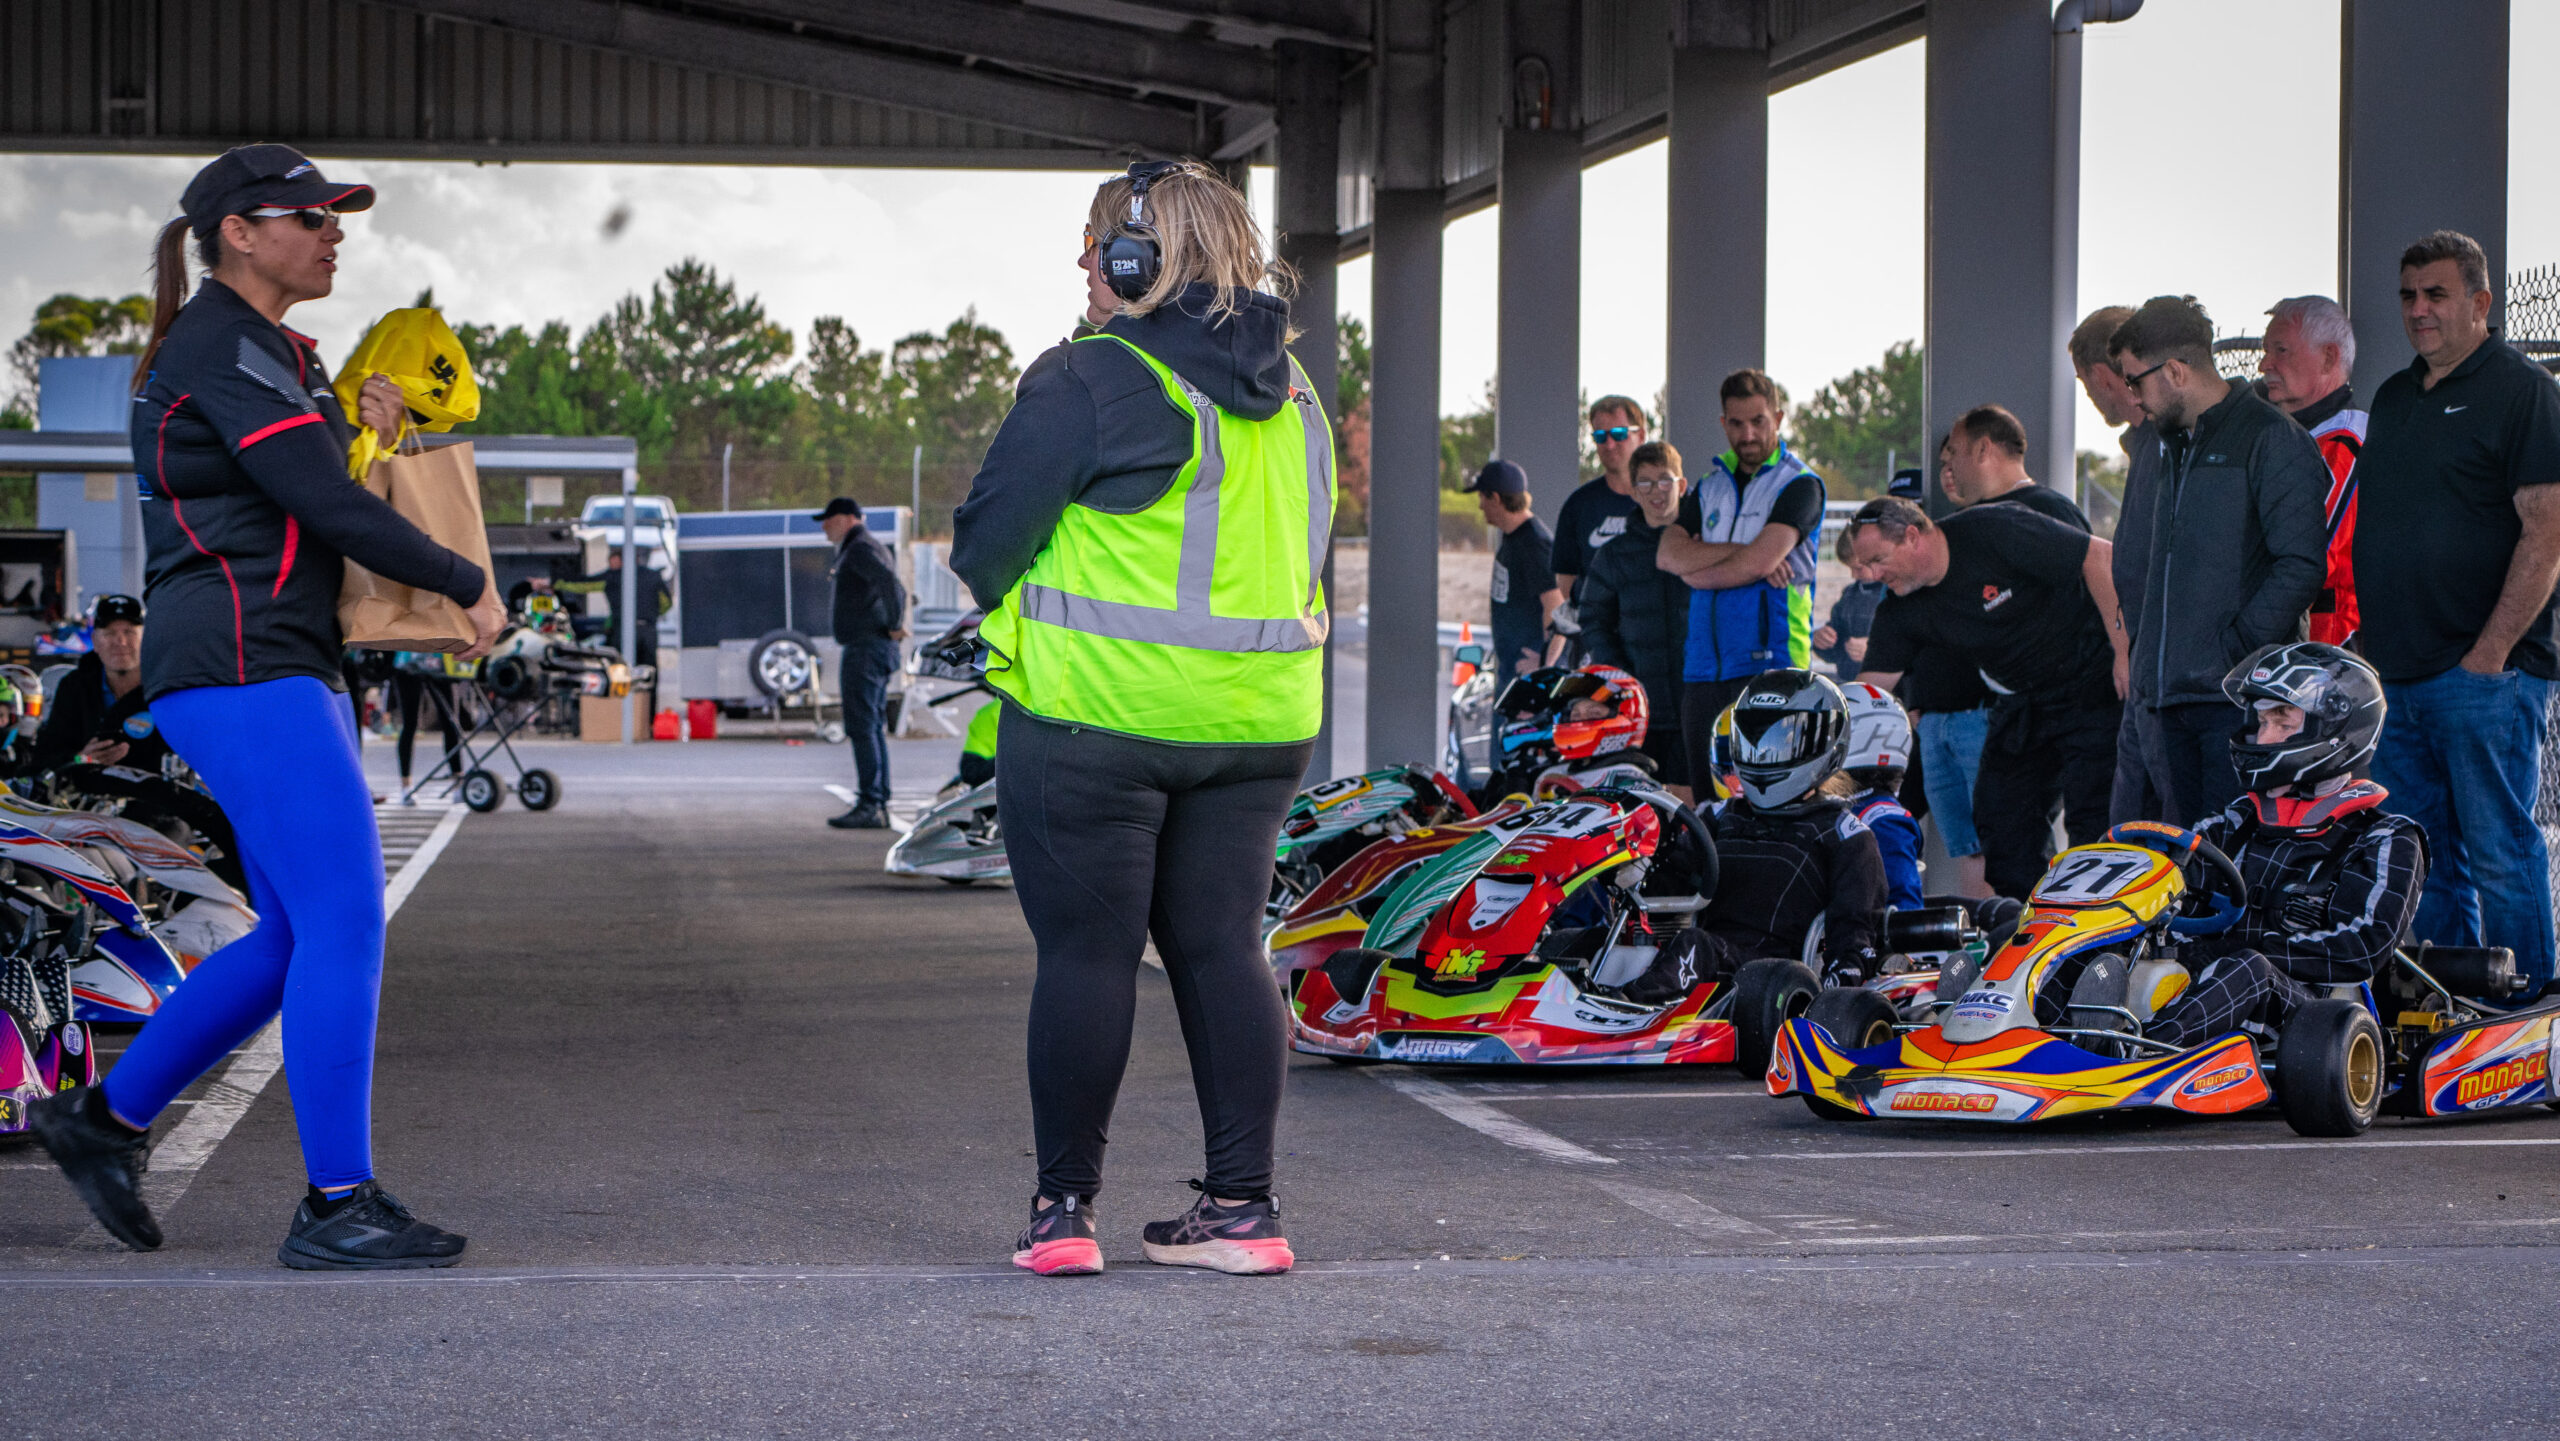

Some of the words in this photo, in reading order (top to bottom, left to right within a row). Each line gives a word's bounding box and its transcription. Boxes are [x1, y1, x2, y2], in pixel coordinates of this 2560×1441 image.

[1752, 695, 1785, 705] HJC
[2042, 858, 2138, 894] 21
[1959, 991, 2014, 1007] MKC
[1389, 1036, 1480, 1058] ARROW
[2475, 1095, 2499, 1109] GP
